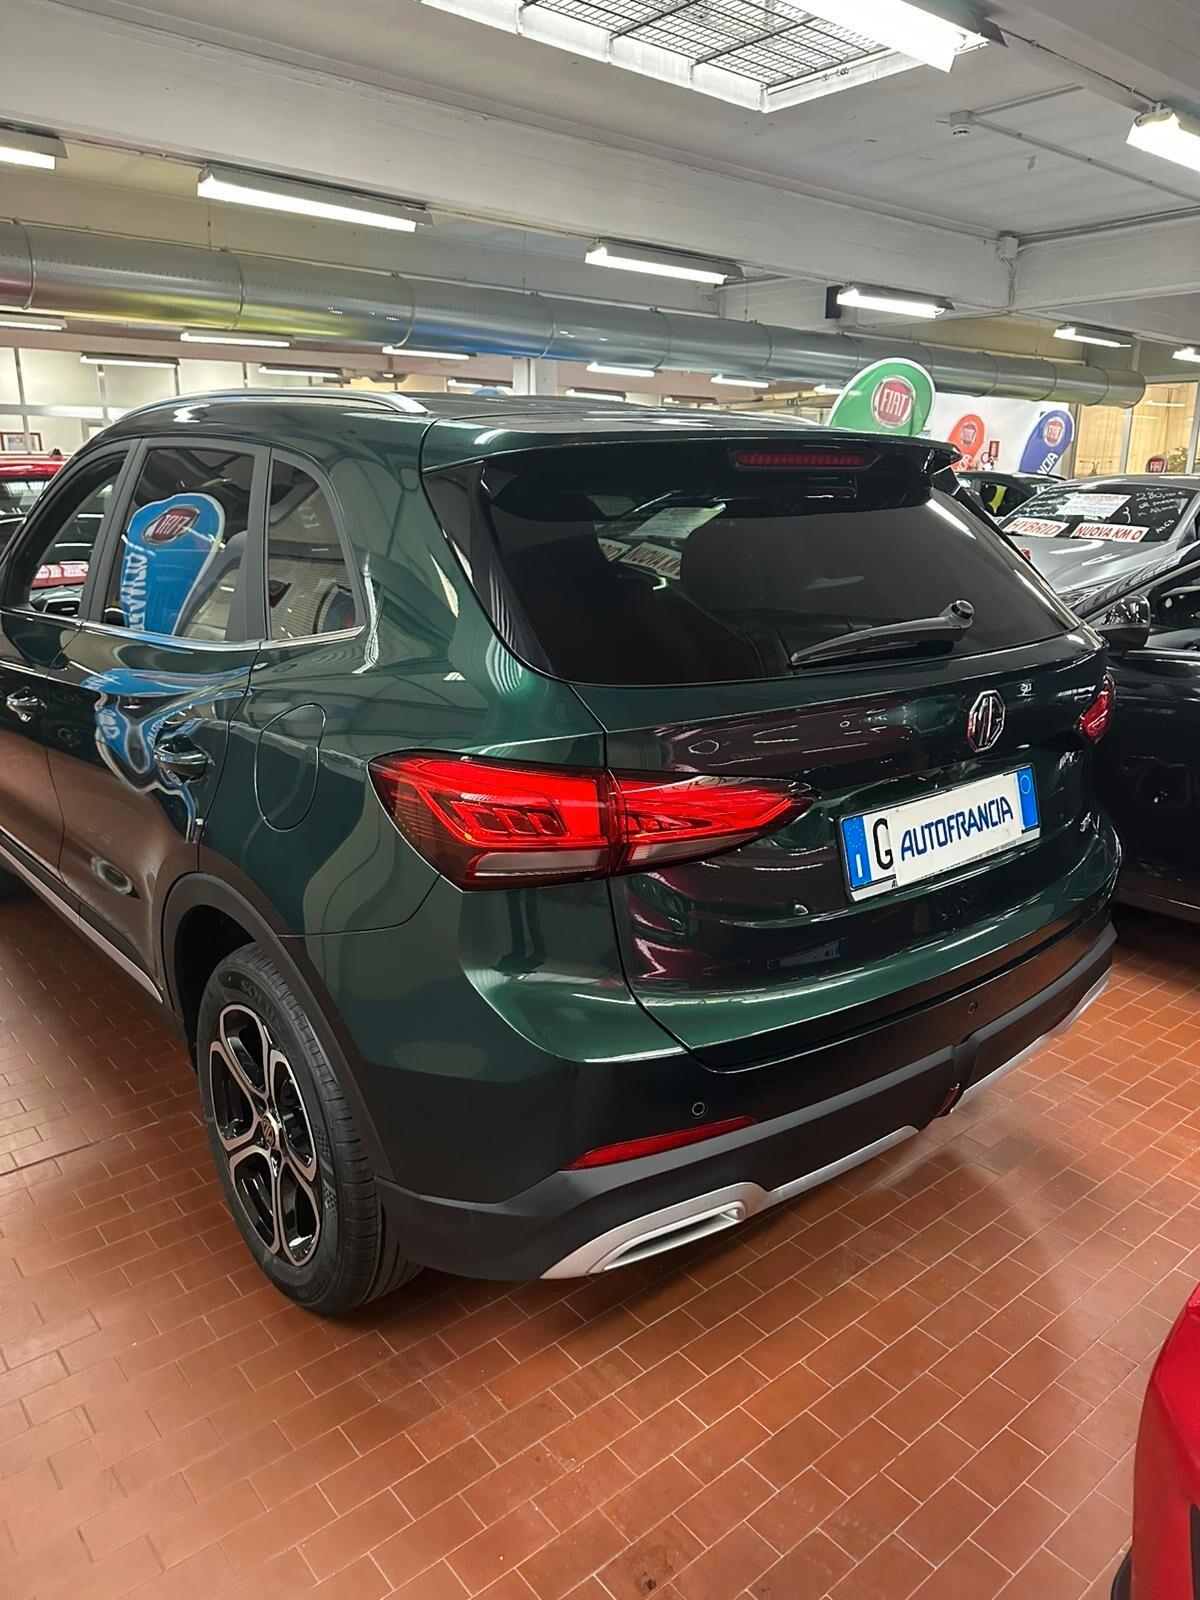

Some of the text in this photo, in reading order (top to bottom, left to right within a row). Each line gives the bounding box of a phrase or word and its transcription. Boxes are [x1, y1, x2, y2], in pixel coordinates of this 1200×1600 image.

[881, 388, 909, 417] FIAT
[1009, 518, 1061, 536] HYBRID
[1075, 525, 1110, 539] NUOVA
[1114, 528, 1131, 540] KM
[972, 695, 1003, 747] MG
[872, 817, 894, 870] G
[901, 796, 1014, 861] AUTOFRANCIA
